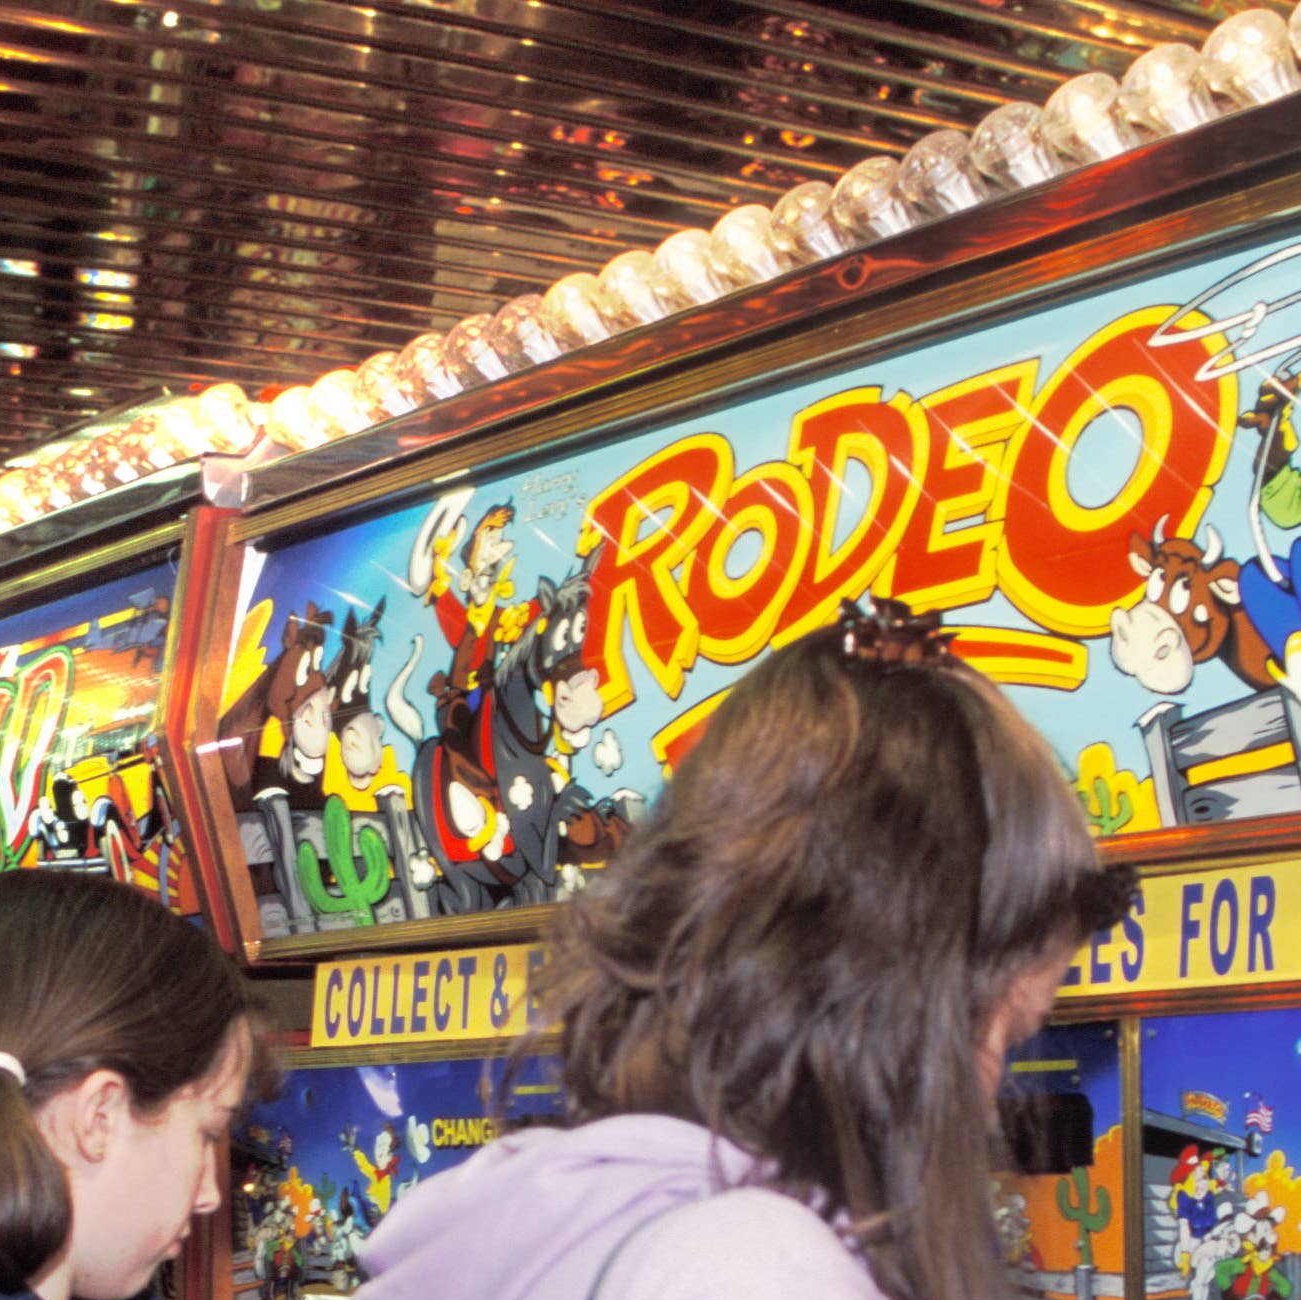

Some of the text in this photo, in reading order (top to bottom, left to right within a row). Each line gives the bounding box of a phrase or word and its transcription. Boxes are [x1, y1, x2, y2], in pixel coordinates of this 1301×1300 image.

[577, 304, 1239, 718] RODEO
[1179, 875, 1276, 978] FOR
[324, 956, 477, 1039] COLLECT
[489, 952, 508, 1030] &
[432, 1117, 495, 1147] CHANG
